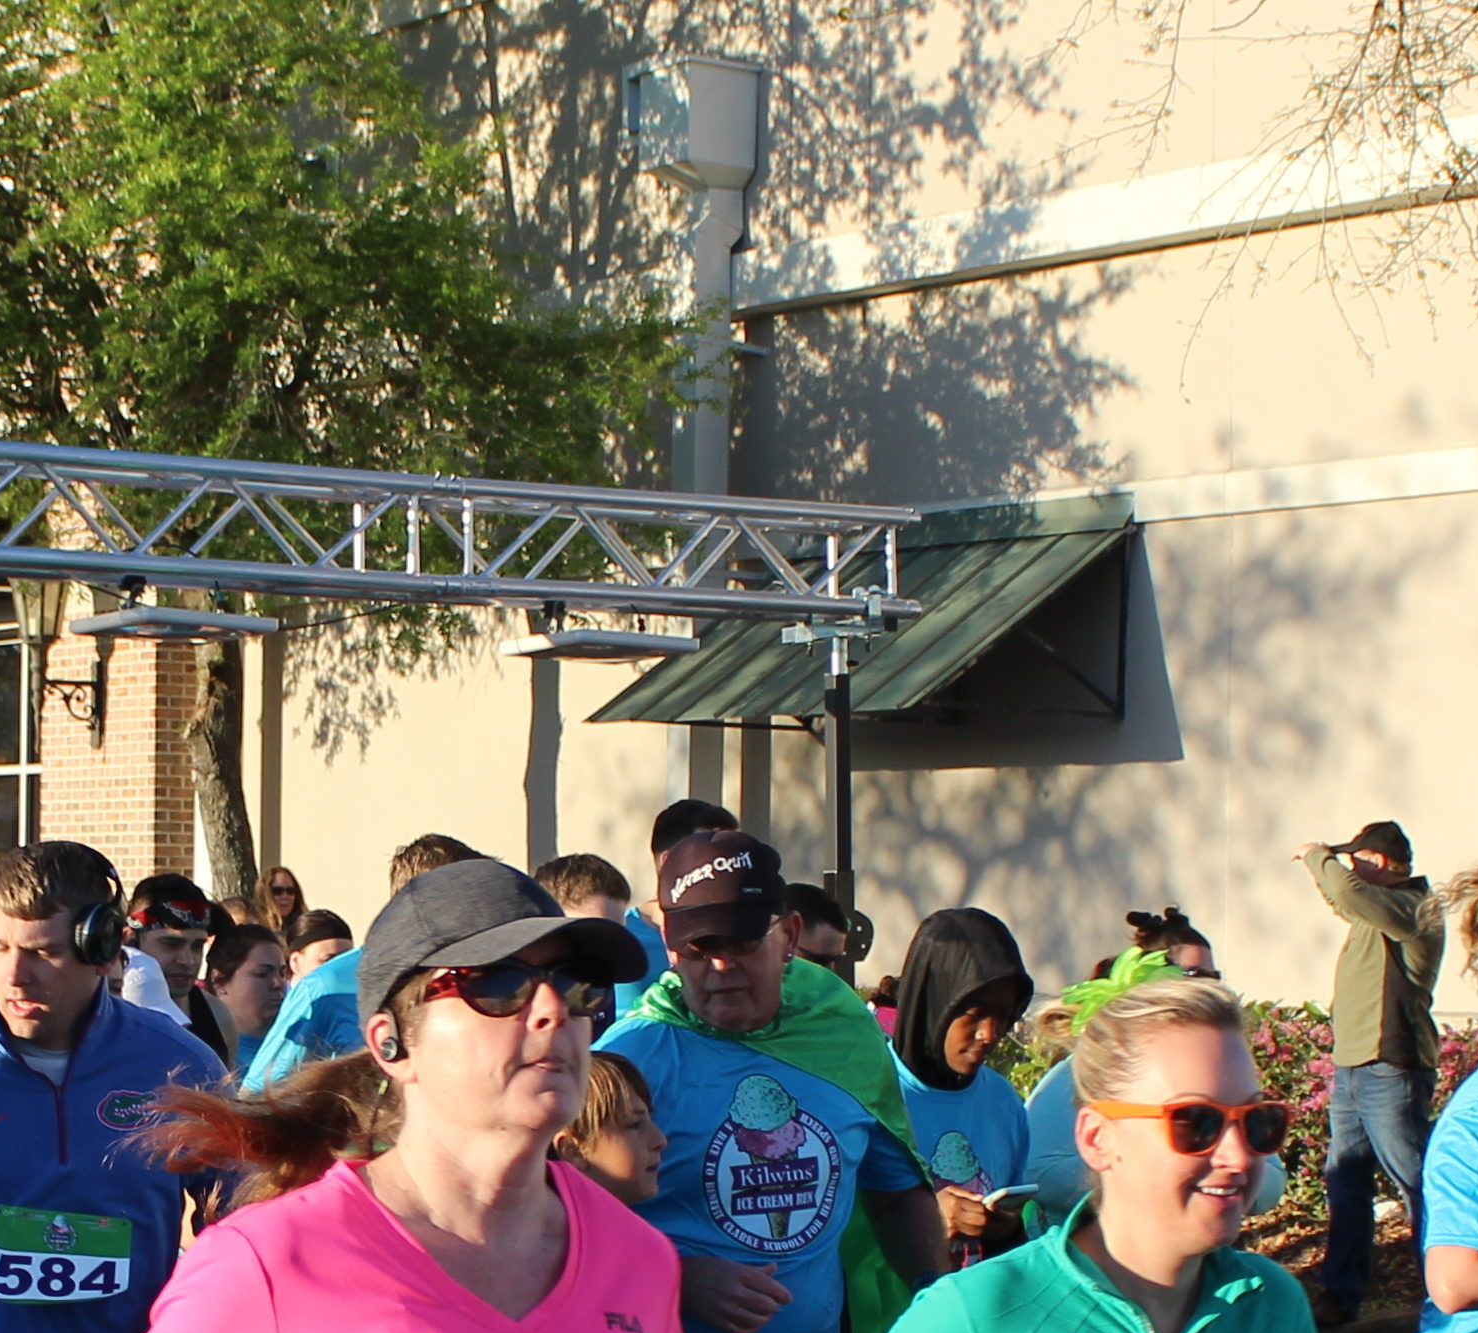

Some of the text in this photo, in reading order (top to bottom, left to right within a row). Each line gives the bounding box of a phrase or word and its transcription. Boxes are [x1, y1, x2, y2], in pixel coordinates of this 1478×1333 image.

[740, 1165, 813, 1187] Kilwins
[705, 1162, 716, 1176] TO
[723, 1221, 759, 1248] CLARKE
[763, 1236, 806, 1251] SCHOOLS
[805, 1220, 824, 1239] FOR
[736, 1190, 814, 1211] ICE CREAM RUN
